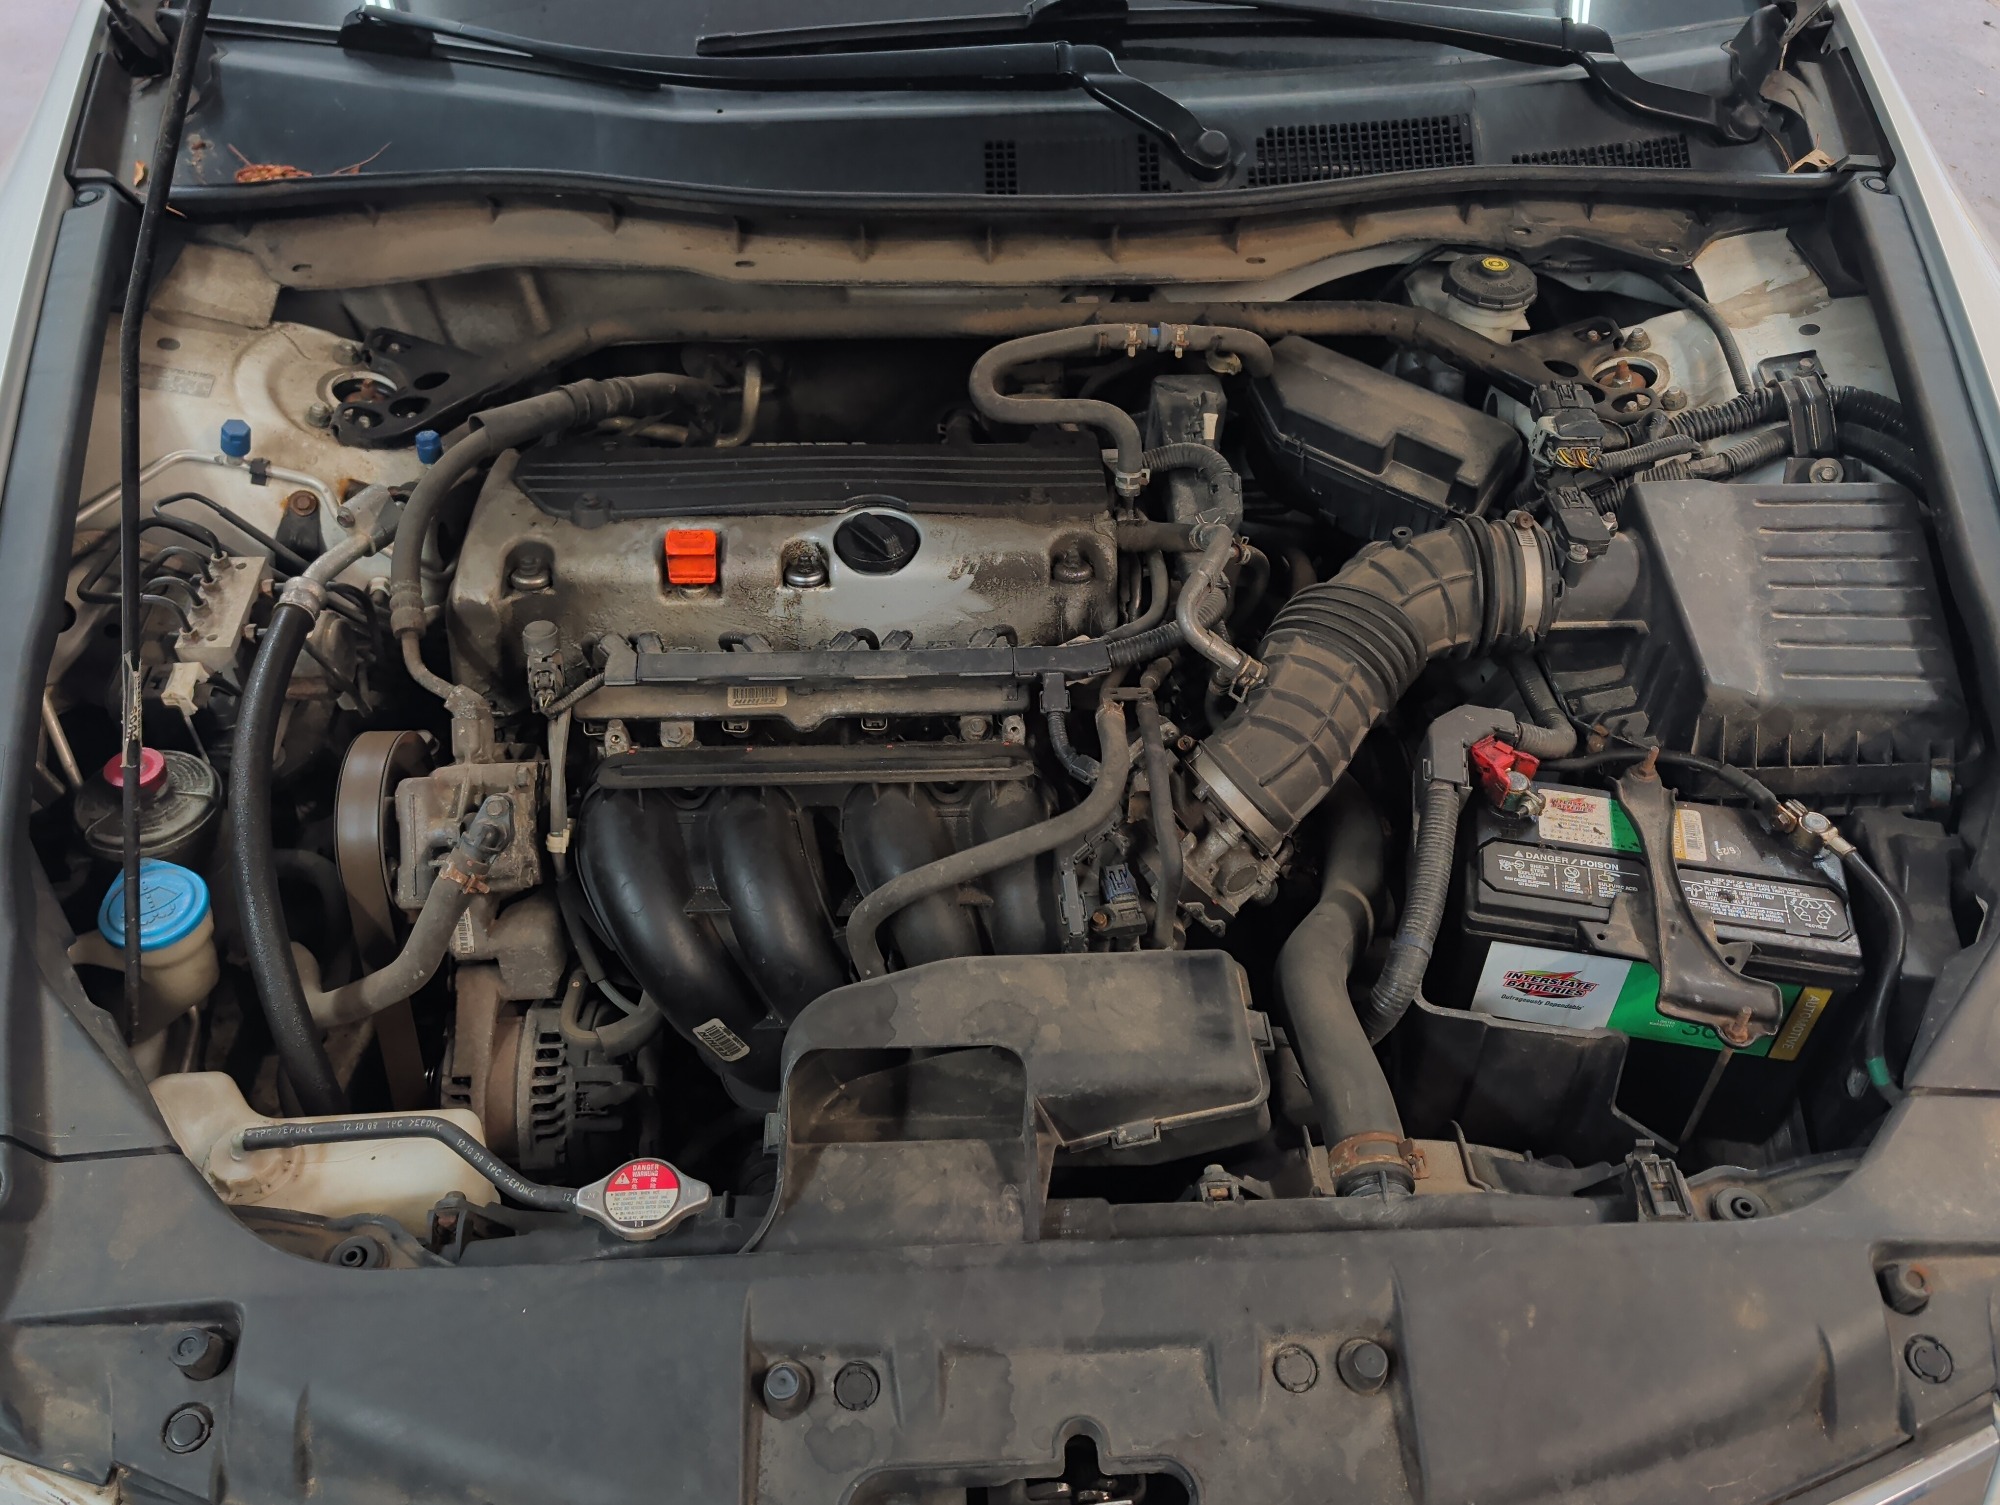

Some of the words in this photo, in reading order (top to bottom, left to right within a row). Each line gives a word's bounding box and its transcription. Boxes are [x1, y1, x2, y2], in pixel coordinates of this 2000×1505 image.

[1526, 852, 1569, 864] DANGER
[1580, 860, 1619, 871] POISON
[1739, 891, 1775, 900] IMMEDIATELY
[1506, 981, 1585, 996] BATTERIES
[1507, 972, 1595, 990] INTERSTATE
[1501, 994, 1543, 1006] Outrageously
[1783, 994, 1820, 1050] AUTOMOTIVE
[486, 1162, 501, 1177] TPC
